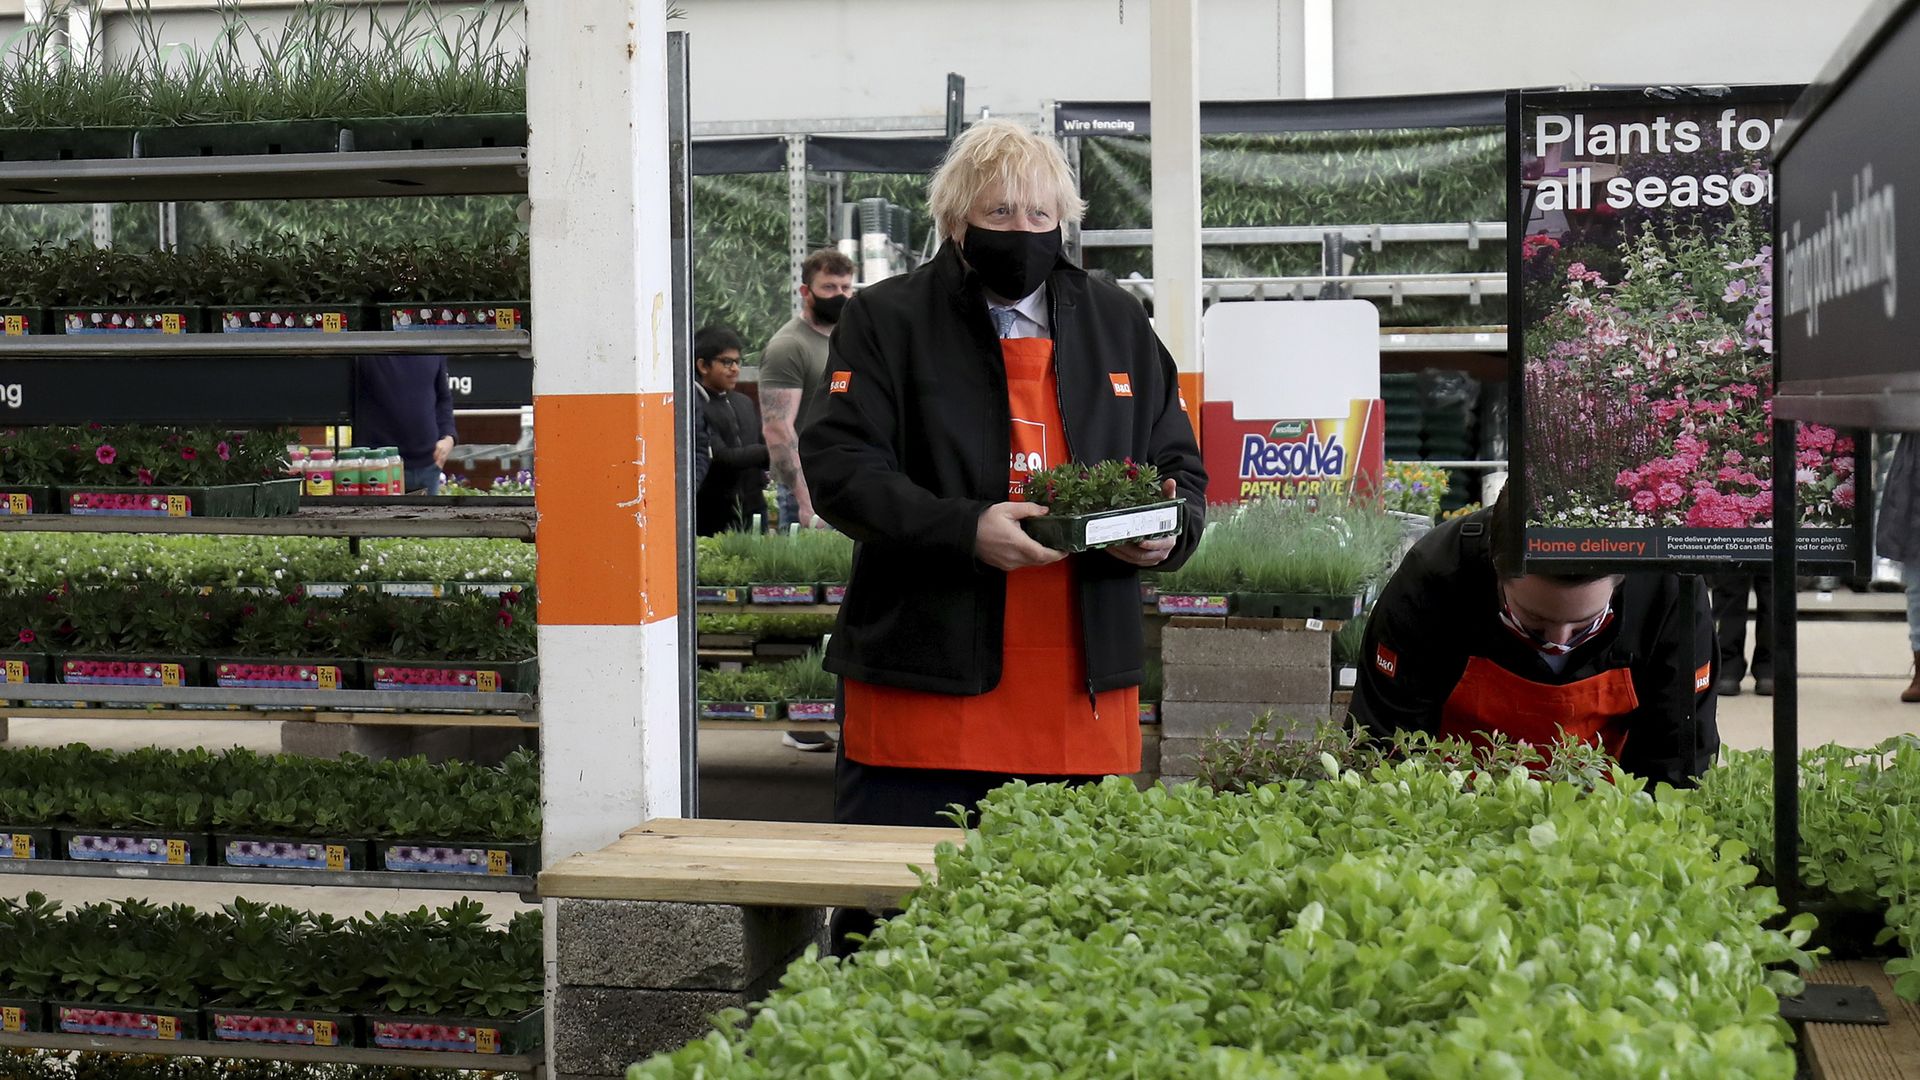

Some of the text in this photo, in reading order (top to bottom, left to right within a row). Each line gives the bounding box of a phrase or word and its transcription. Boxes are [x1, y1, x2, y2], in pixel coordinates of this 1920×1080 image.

[1064, 119, 1134, 132] Wire fencing
[1536, 114, 1701, 157] Plants
[1535, 167, 1773, 211] all seaso
[1831, 162, 1897, 320] bedding
[448, 373, 472, 394] ng
[1114, 383, 1131, 392] B&Q
[1010, 452, 1042, 472] &Q
[1240, 480, 1280, 497] PATH
[1528, 538, 1646, 556] Home delivery
[1684, 536, 1712, 544] delivery
[1746, 536, 1767, 544] spend
